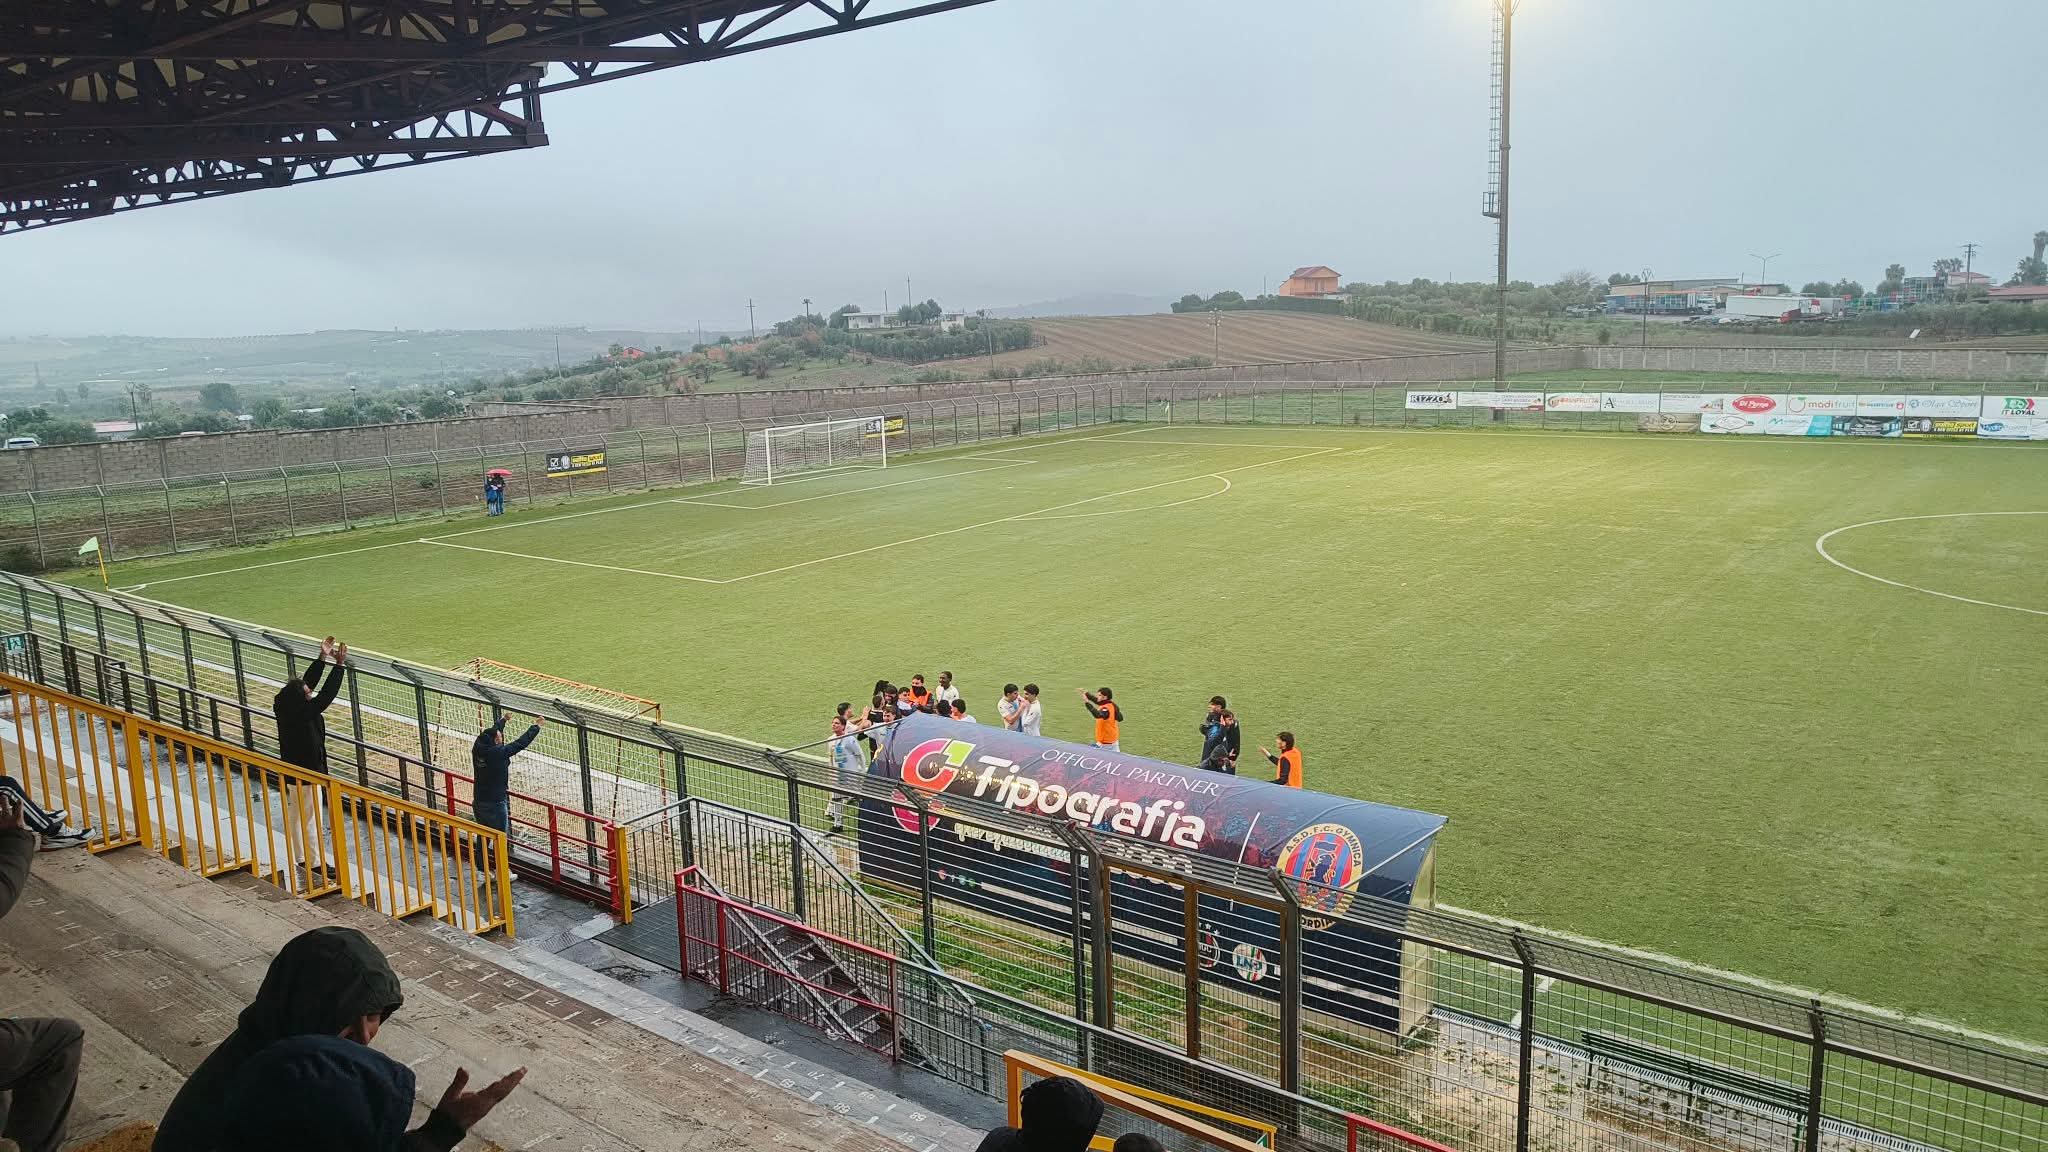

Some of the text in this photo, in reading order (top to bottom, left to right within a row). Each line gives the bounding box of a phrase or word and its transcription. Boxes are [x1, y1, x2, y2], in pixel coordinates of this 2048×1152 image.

[1041, 749, 1220, 797] OFFICIAL PARTNER
[974, 755, 1206, 850] Tipografia
[1286, 825, 1362, 867] A.S.D. F.C. GYMNICA
